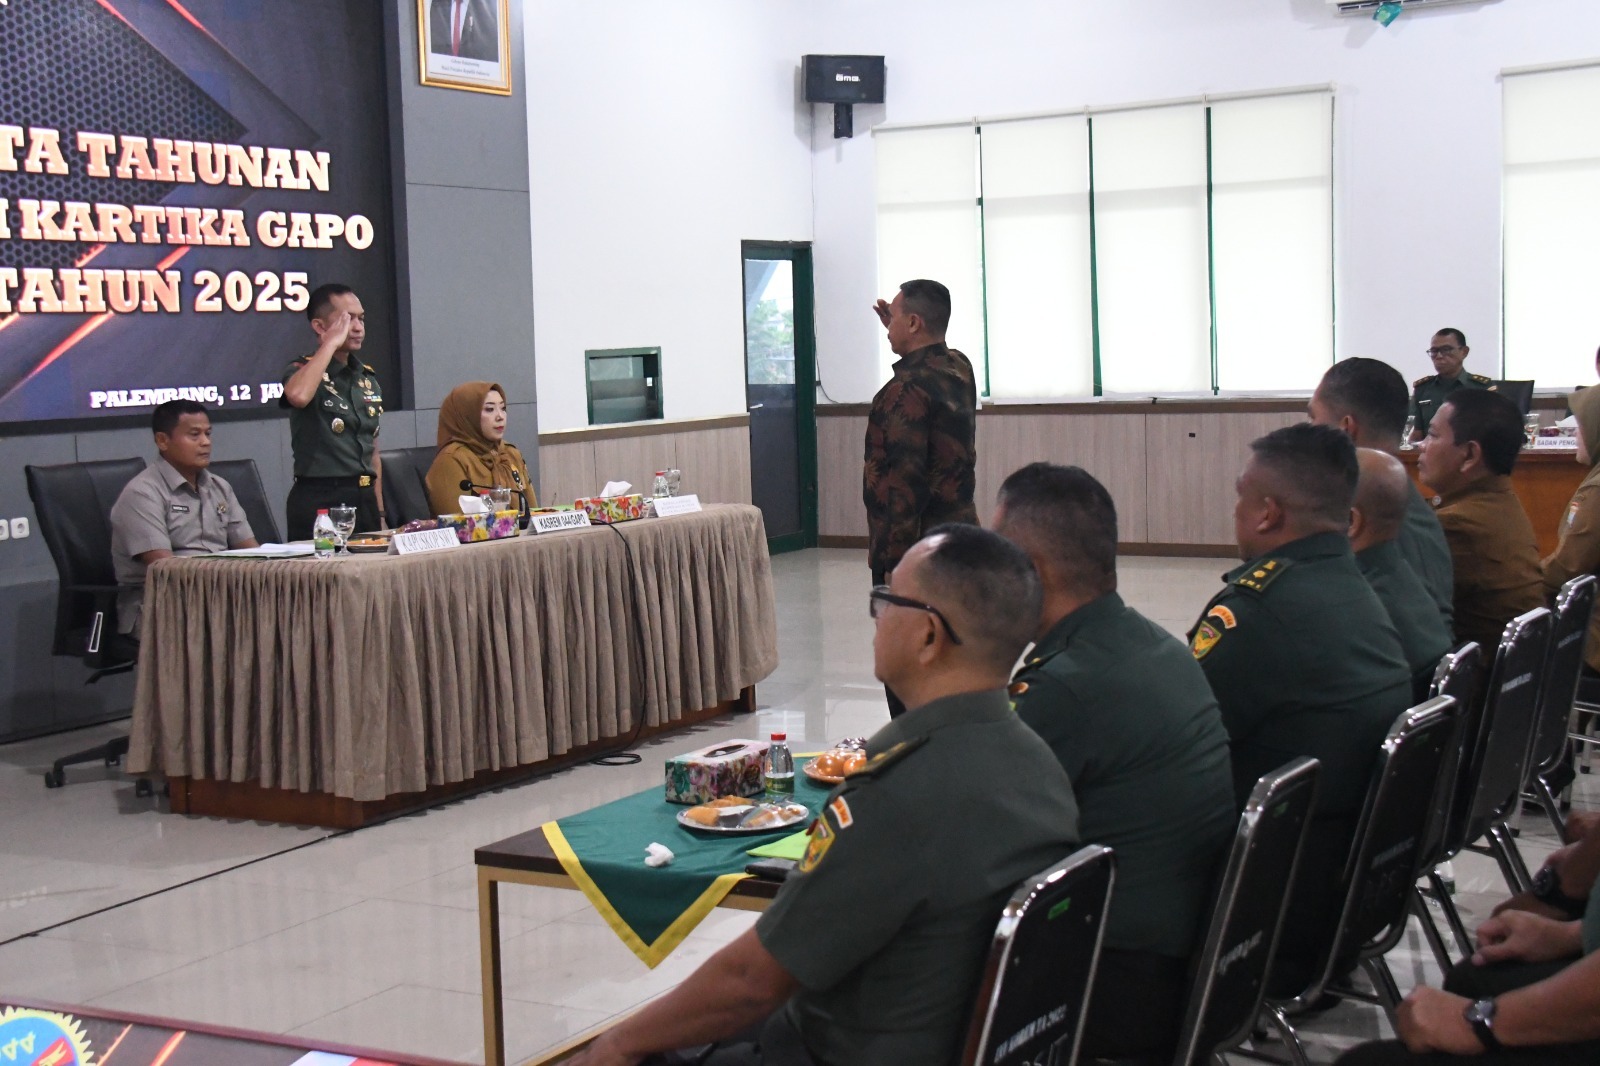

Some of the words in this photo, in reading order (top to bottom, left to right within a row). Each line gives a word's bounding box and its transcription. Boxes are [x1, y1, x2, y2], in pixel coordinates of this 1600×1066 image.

[0, 124, 69, 175] TA
[77, 131, 330, 192] TAHUNAN
[18, 199, 250, 247] KARTIKA
[257, 210, 374, 250] GAPO
[0, 267, 181, 312] TAHUN
[194, 270, 310, 312] 2025
[230, 385, 251, 400] 12
